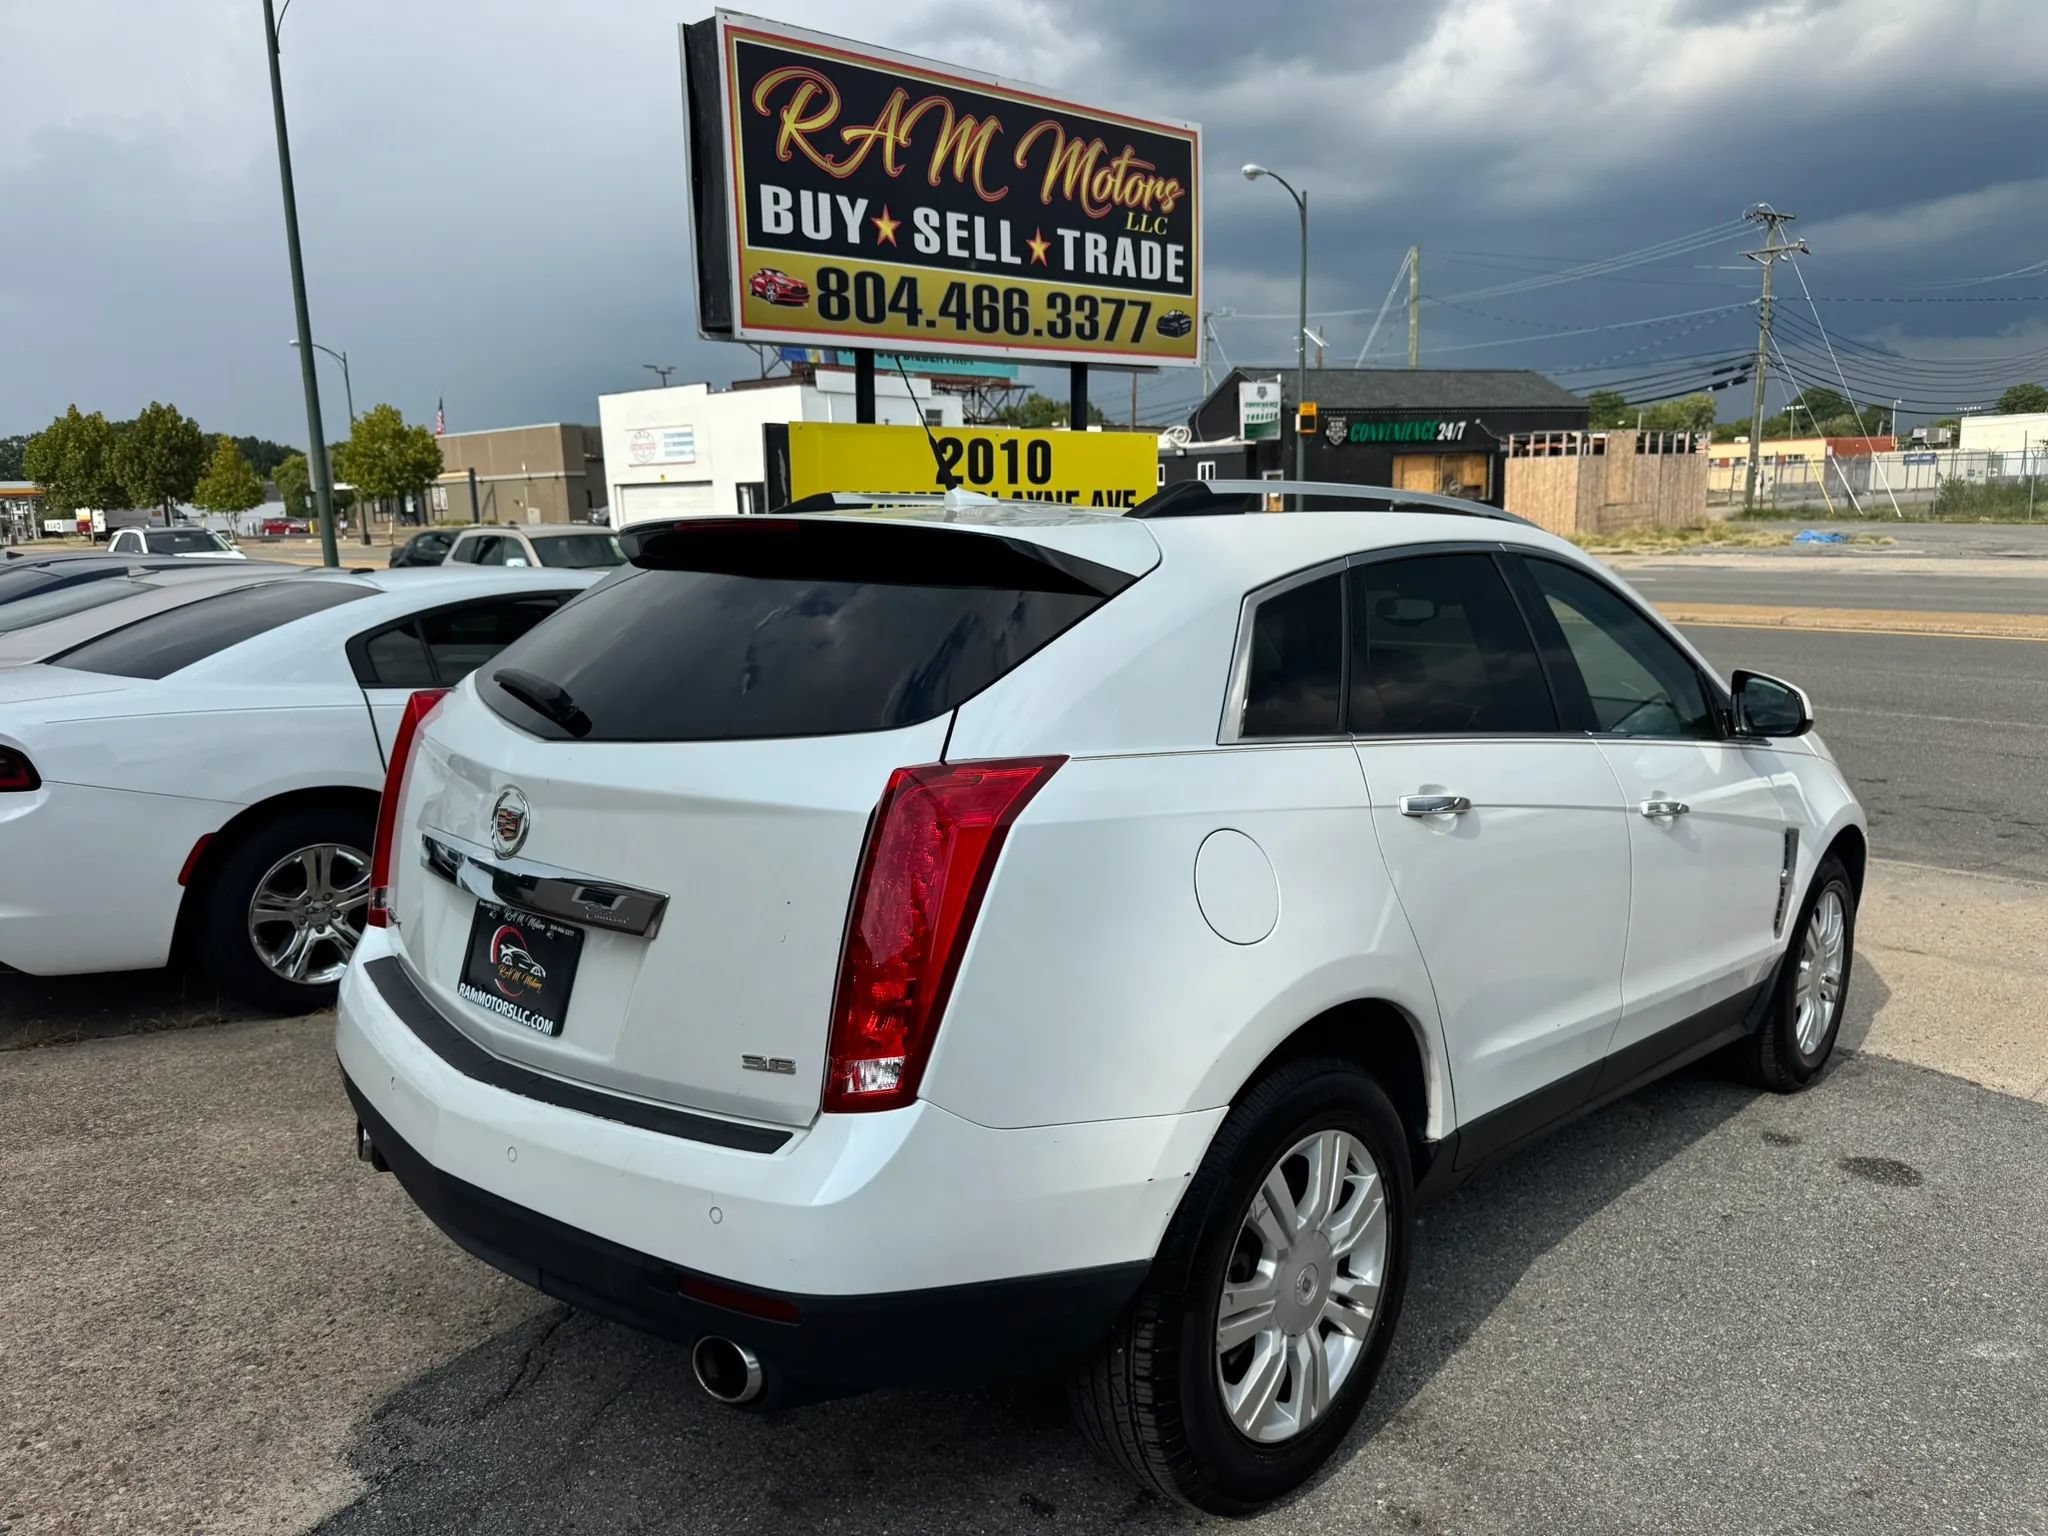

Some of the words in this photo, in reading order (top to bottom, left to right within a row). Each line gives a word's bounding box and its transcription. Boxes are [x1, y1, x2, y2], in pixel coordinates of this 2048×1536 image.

[752, 66, 1008, 202] RAM
[1013, 119, 1186, 218] Motors
[760, 183, 868, 244] BUY
[912, 207, 1021, 265] SELL
[1057, 227, 1185, 283] TRADE
[1125, 211, 1168, 236] LLC
[816, 266, 1152, 344] 804.466.3377
[935, 436, 1052, 486] 2010
